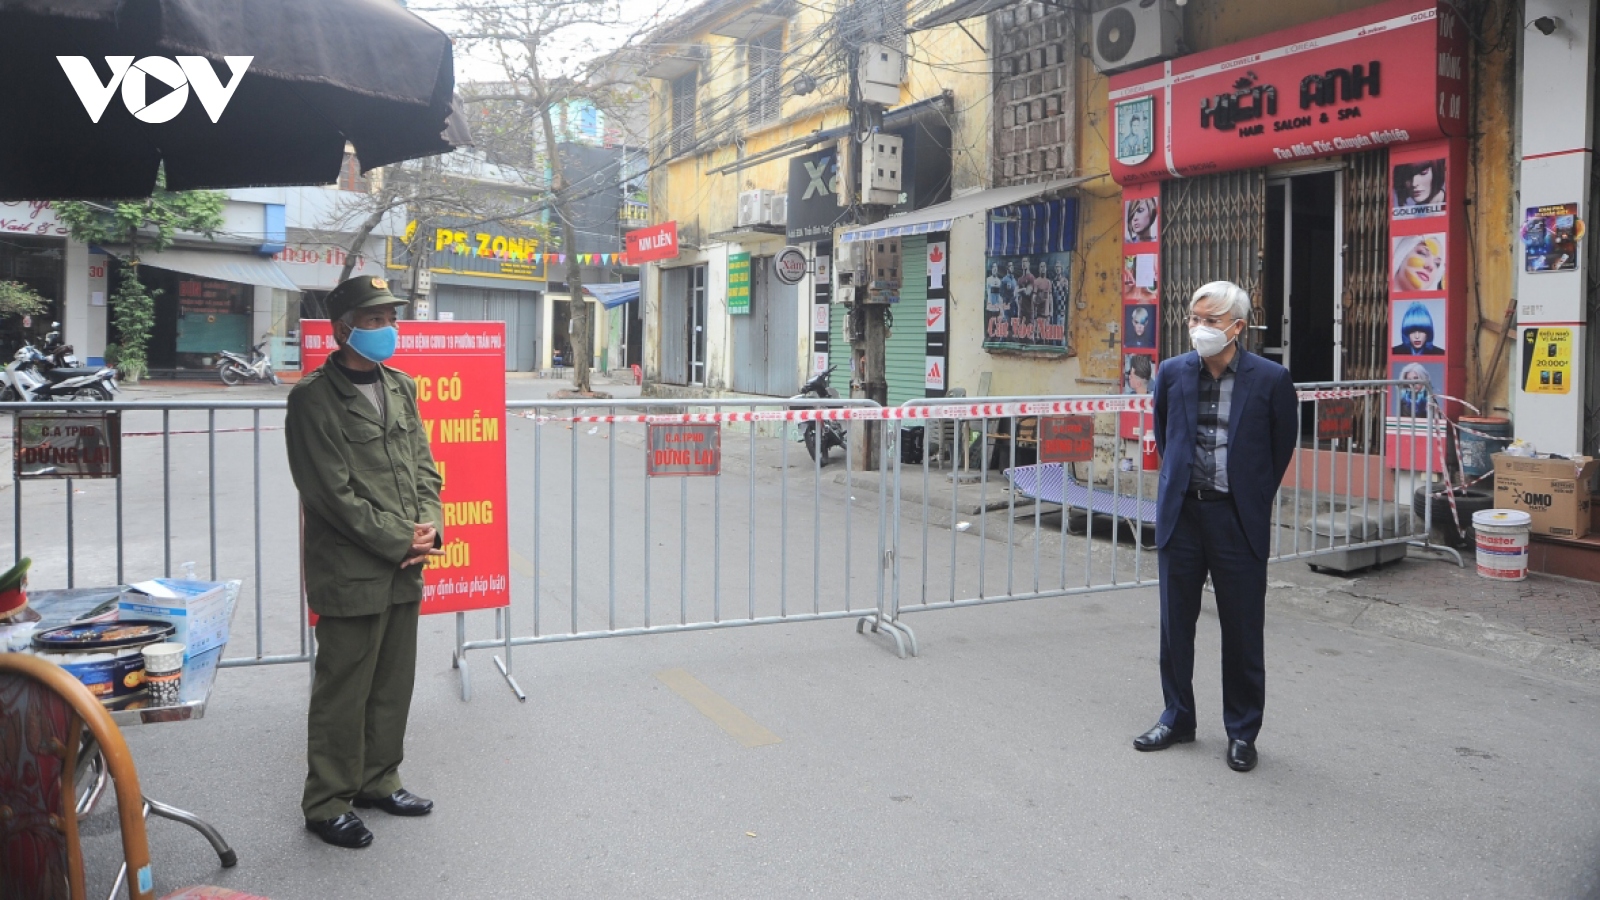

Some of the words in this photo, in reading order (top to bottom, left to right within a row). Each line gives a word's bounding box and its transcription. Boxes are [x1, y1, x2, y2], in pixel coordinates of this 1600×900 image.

[1411, 10, 1438, 22] GOLD
[1239, 124, 1264, 138] HAIR
[1273, 115, 1312, 132] SALON
[1319, 112, 1329, 123] &
[1337, 106, 1361, 121] SPA
[1313, 140, 1334, 152] Tóc
[1393, 204, 1441, 217] GOLDWELL
[476, 233, 539, 260] ZONE
[652, 229, 672, 248] LIÊN
[415, 332, 429, 352] BỆNH
[429, 334, 446, 350] COVID
[447, 334, 453, 350] 19
[437, 371, 462, 402] CÓ
[440, 409, 499, 443] NHIỄM
[655, 447, 690, 466] DỪNG
[1524, 492, 1552, 506] OMO
[437, 578, 454, 600] định
[455, 576, 469, 594] của
[469, 575, 488, 598] pháp
